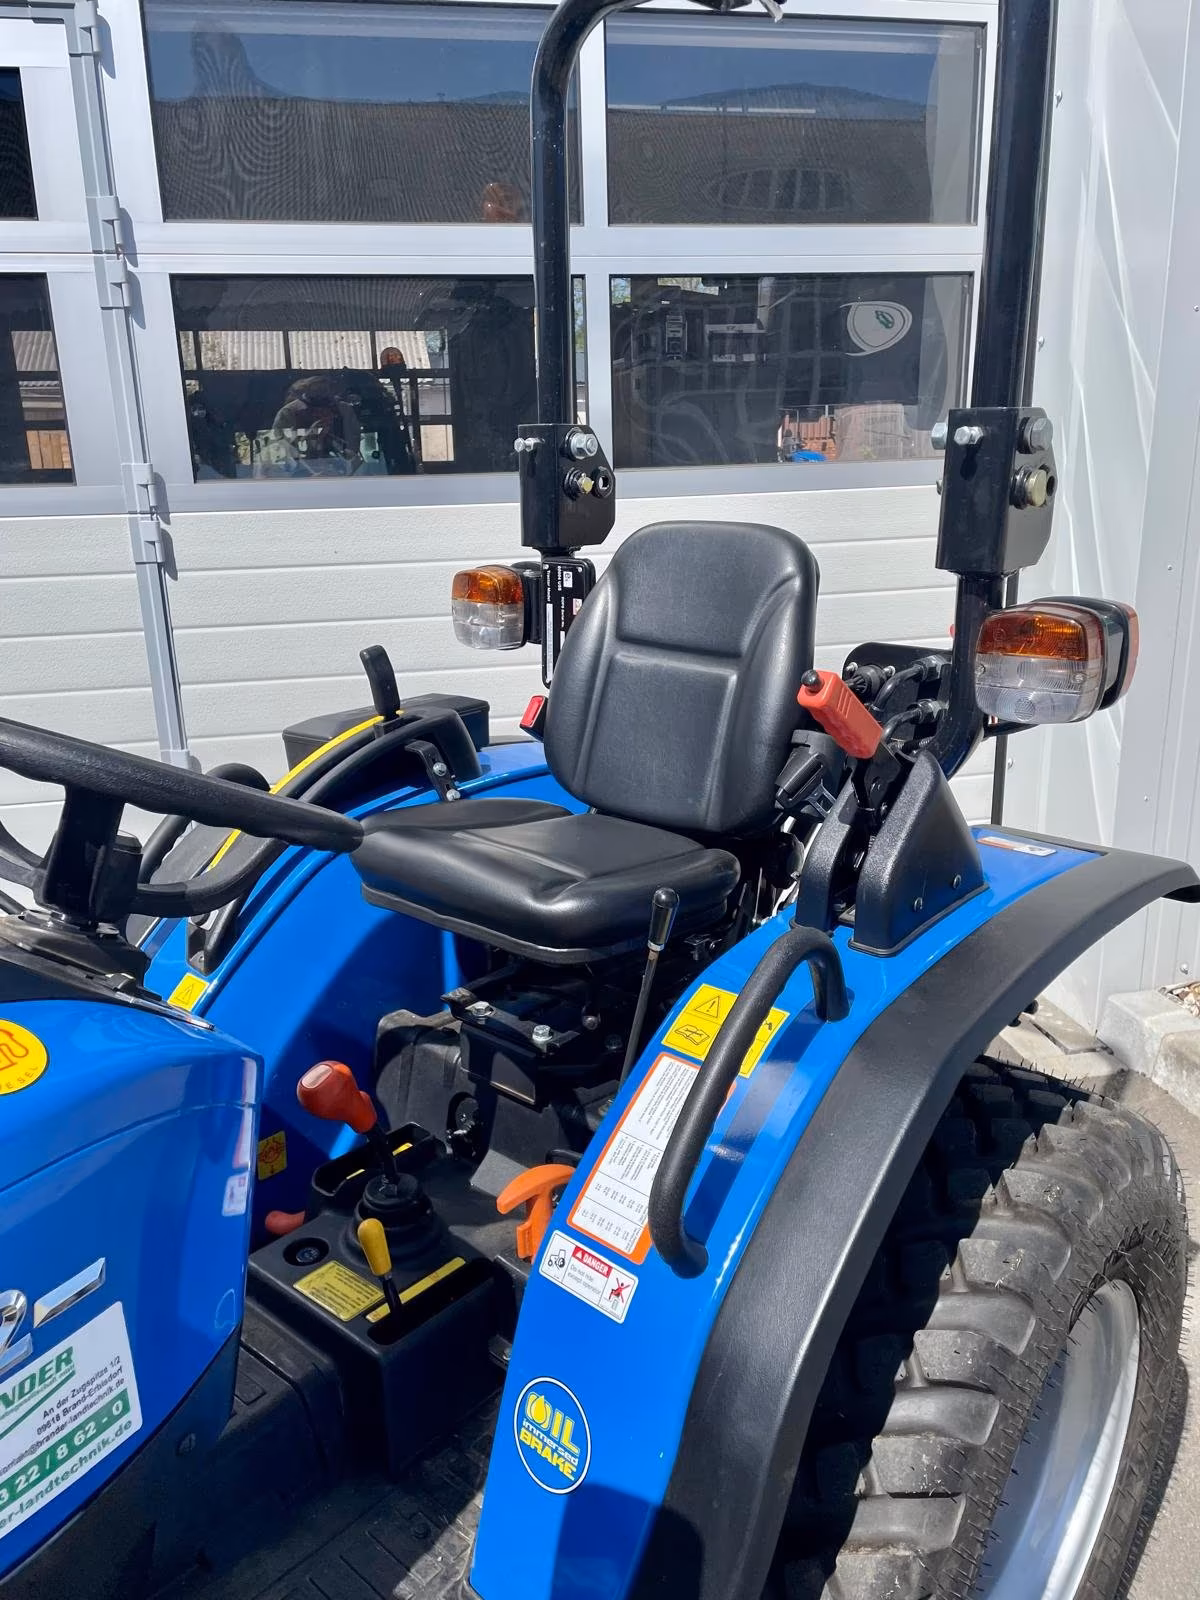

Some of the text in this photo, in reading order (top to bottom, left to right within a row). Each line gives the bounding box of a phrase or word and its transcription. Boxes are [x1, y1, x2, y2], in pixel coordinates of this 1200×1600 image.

[567, 1272, 582, 1284] except
[582, 1281, 601, 1295] operator
[570, 1263, 577, 1272] Do
[582, 1252, 609, 1277] DANGER
[42, 1355, 121, 1419] An der Zugspitze 1/2
[62, 1366, 123, 1418] Brand-Erbisdorf
[15, 1465, 41, 1494] 22
[45, 1454, 50, 1470] /
[56, 1443, 69, 1460] 8
[73, 1421, 97, 1446] 62
[112, 1401, 123, 1416] 0
[525, 1391, 581, 1457] OIL
[519, 1427, 577, 1482] BRAKE
